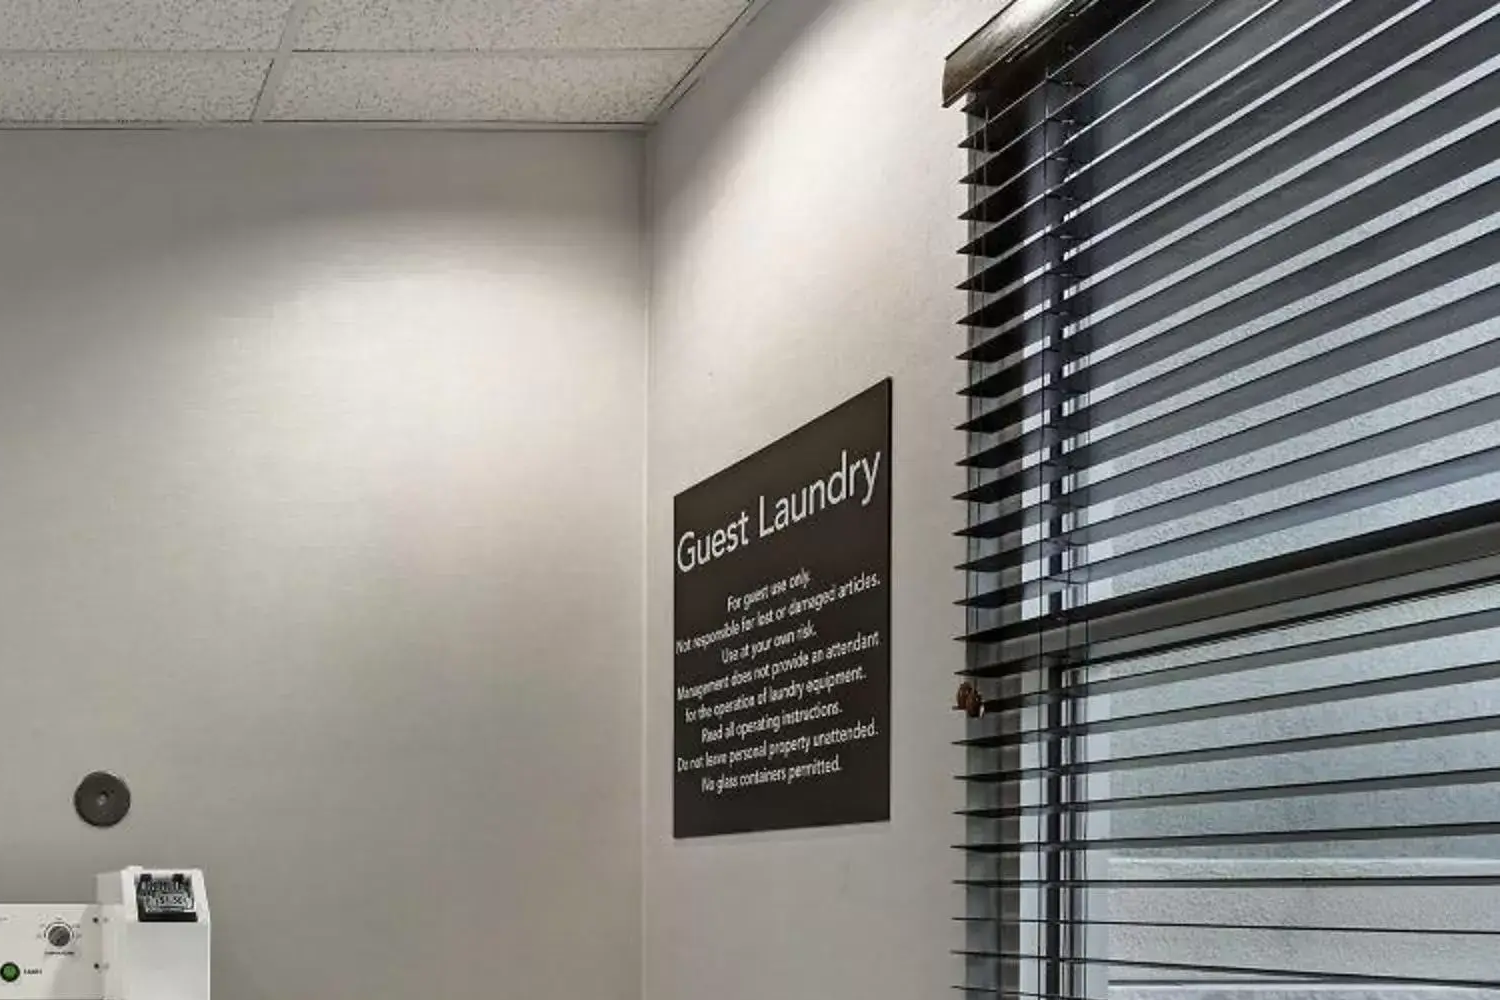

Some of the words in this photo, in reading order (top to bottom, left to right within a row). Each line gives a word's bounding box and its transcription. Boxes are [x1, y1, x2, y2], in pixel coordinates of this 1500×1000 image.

[677, 512, 749, 573] Guest
[759, 450, 880, 538] Laundry
[676, 638, 691, 655] Not
[692, 620, 740, 651] responsible
[741, 615, 755, 633] for
[757, 609, 774, 627] lost
[775, 605, 787, 621] or
[788, 585, 836, 616] damaged
[837, 571, 881, 599] articles.
[727, 595, 741, 612] For
[743, 584, 769, 611] guest
[770, 580, 787, 596] use
[677, 675, 729, 701] Management
[730, 669, 752, 687] does
[753, 663, 770, 680] not
[771, 650, 809, 681] provide
[810, 648, 825, 665] an
[825, 631, 879, 660] attendant
[721, 647, 738, 664] Use
[740, 643, 749, 659] at
[751, 637, 772, 660] your
[774, 631, 795, 648] own
[685, 706, 697, 723] for
[698, 703, 713, 720] the
[713, 694, 755, 721] operation
[757, 686, 767, 705] of
[768, 679, 805, 702] laundry
[701, 722, 723, 743] Read
[724, 719, 735, 740] all
[735, 713, 780, 741] operating
[677, 756, 689, 773] Do
[690, 755, 704, 769] not
[705, 750, 727, 768] leave
[728, 739, 767, 769] personal
[768, 735, 811, 760] property
[701, 777, 715, 793] No
[716, 772, 739, 795] glass
[739, 766, 787, 787] containers
